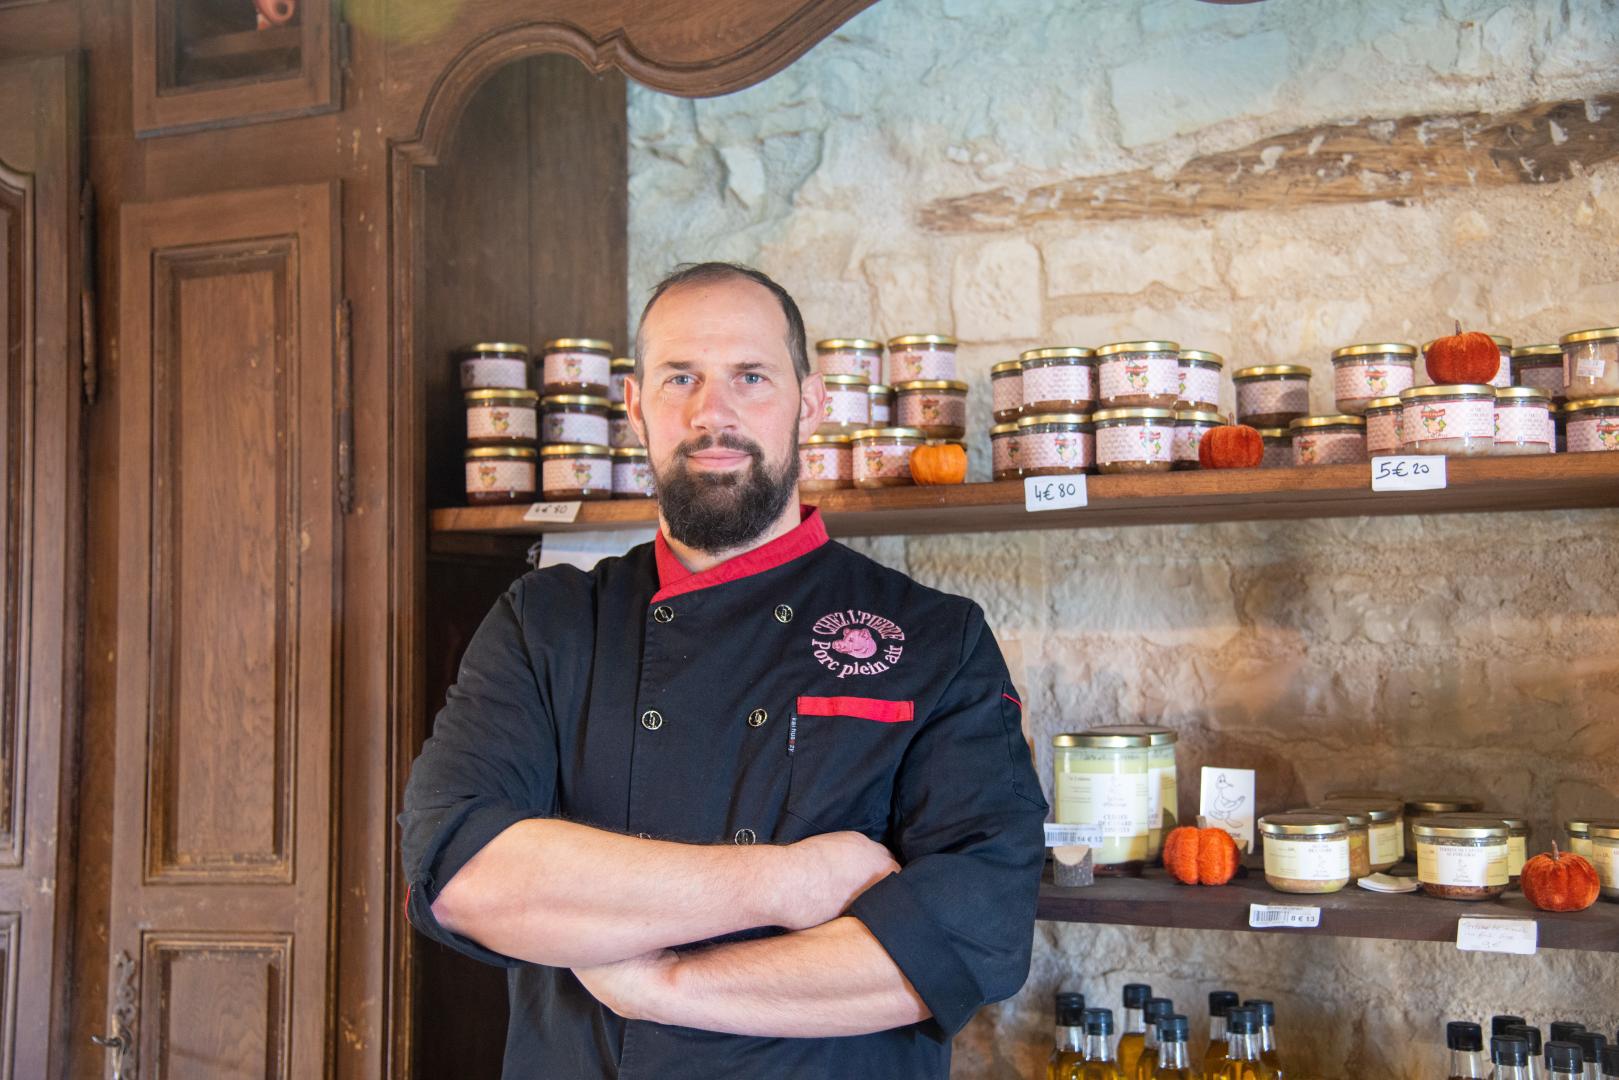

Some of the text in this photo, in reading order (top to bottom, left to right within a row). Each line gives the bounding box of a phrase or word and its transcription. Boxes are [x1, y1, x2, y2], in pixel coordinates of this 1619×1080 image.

[1412, 462, 1430, 475] 20
[1058, 483, 1076, 498] 80
[812, 611, 850, 635] CHEZ
[812, 638, 903, 679] Porc plein air
